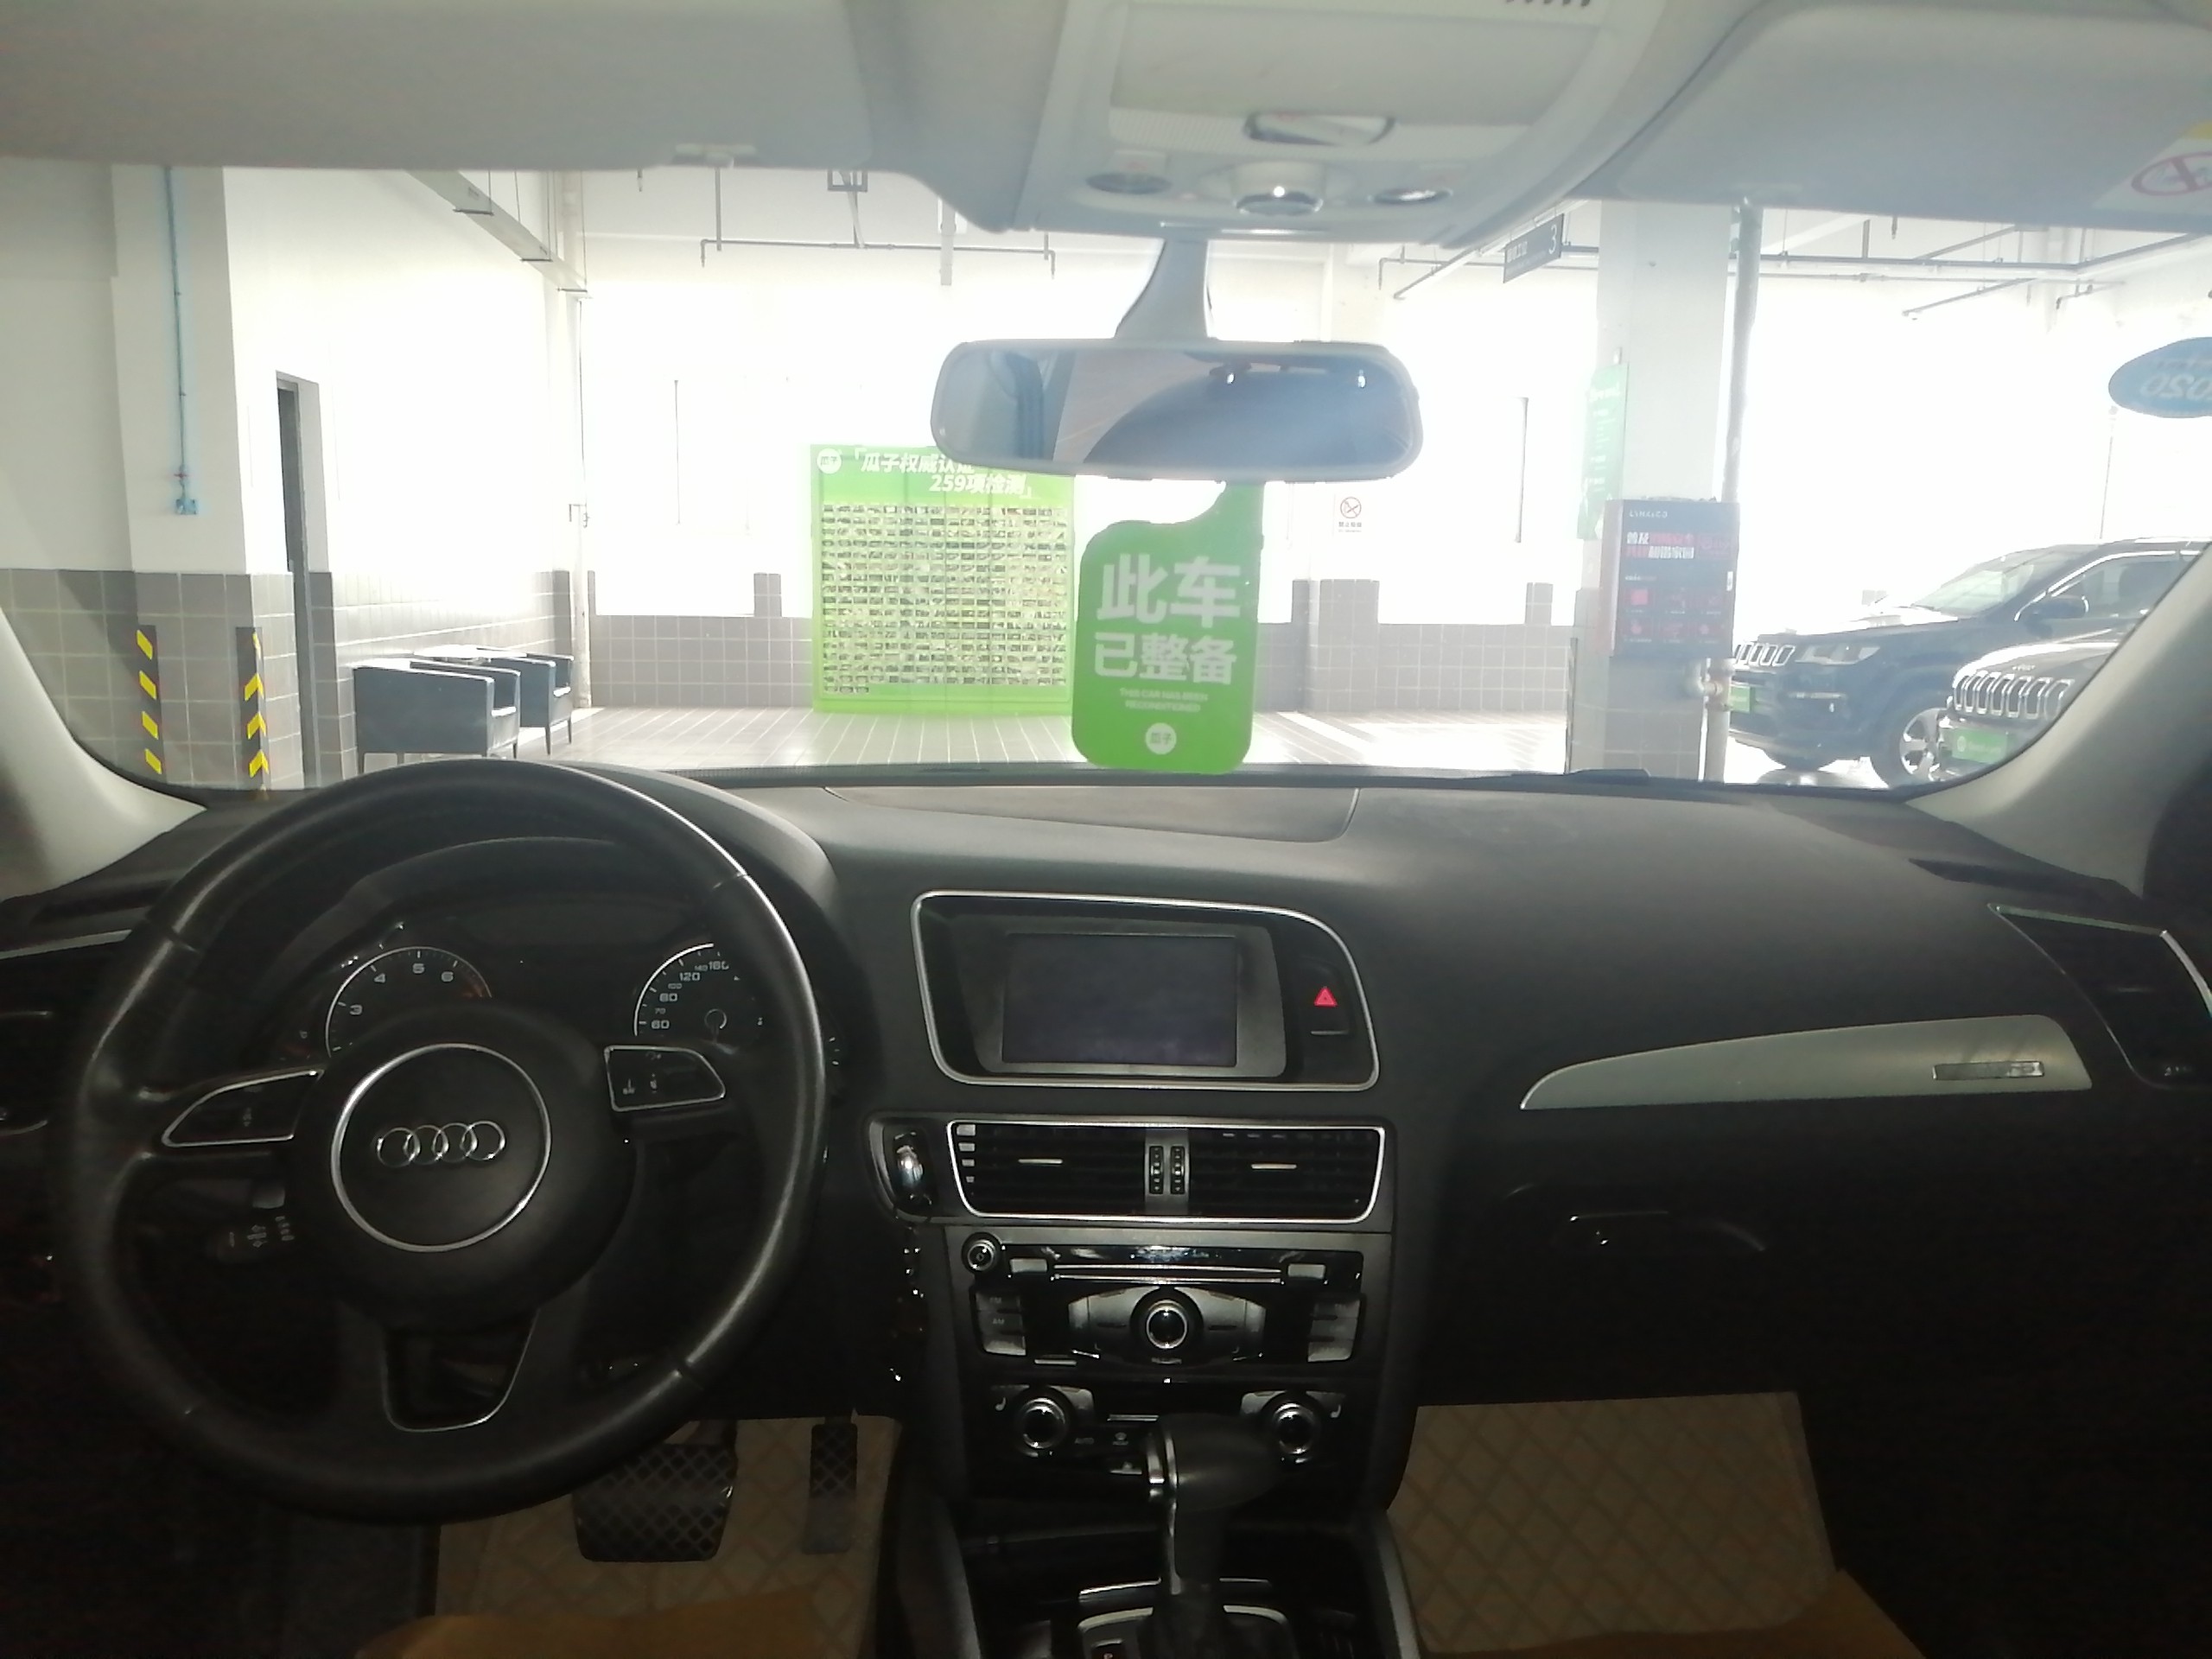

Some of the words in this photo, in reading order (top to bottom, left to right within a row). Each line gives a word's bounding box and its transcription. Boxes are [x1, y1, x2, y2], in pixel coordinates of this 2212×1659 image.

[1548, 224, 1557, 254] 3
[1096, 554, 1241, 628] 此车
[1094, 632, 1237, 685] 已整备
[412, 963, 424, 974] 5
[374, 973, 386, 983] 4
[679, 972, 701, 982] 120
[350, 1005, 363, 1015] 3
